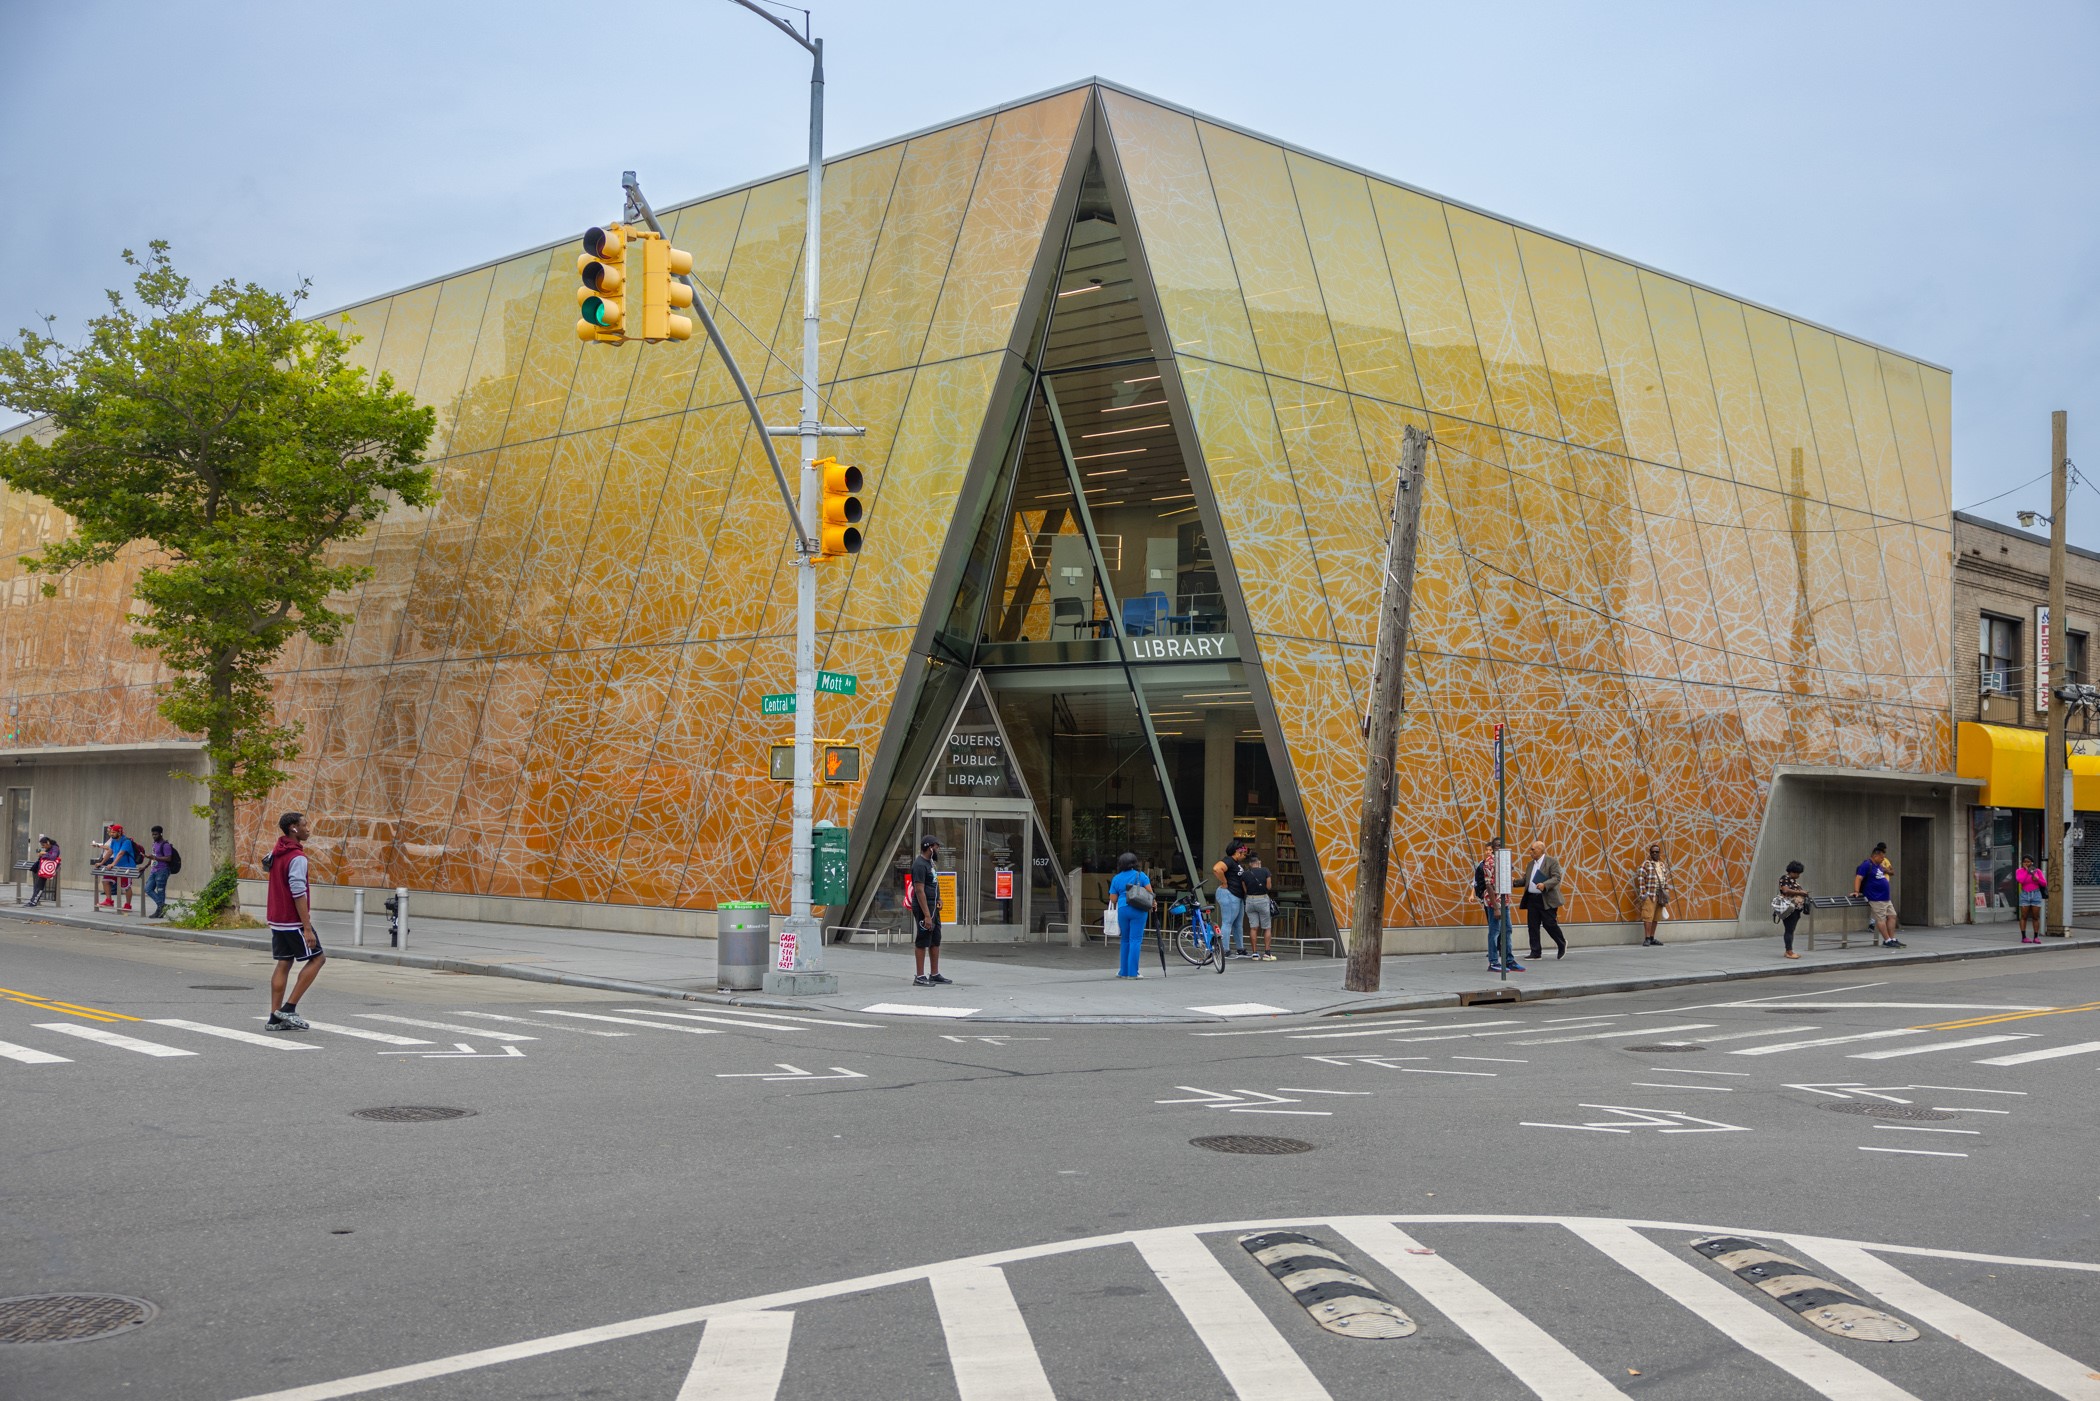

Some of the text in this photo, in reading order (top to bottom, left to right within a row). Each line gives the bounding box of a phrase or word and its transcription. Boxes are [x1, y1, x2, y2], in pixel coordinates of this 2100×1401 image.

[1133, 637, 1225, 658] LIBRARY
[821, 675, 852, 691] Mott Av
[764, 697, 796, 712] Central Av
[950, 735, 1001, 746] QUEENS
[953, 754, 997, 766] PUBLIC
[948, 774, 1000, 786] LIBRARY
[1032, 858, 1050, 866] 1637
[780, 934, 795, 942] CASH
